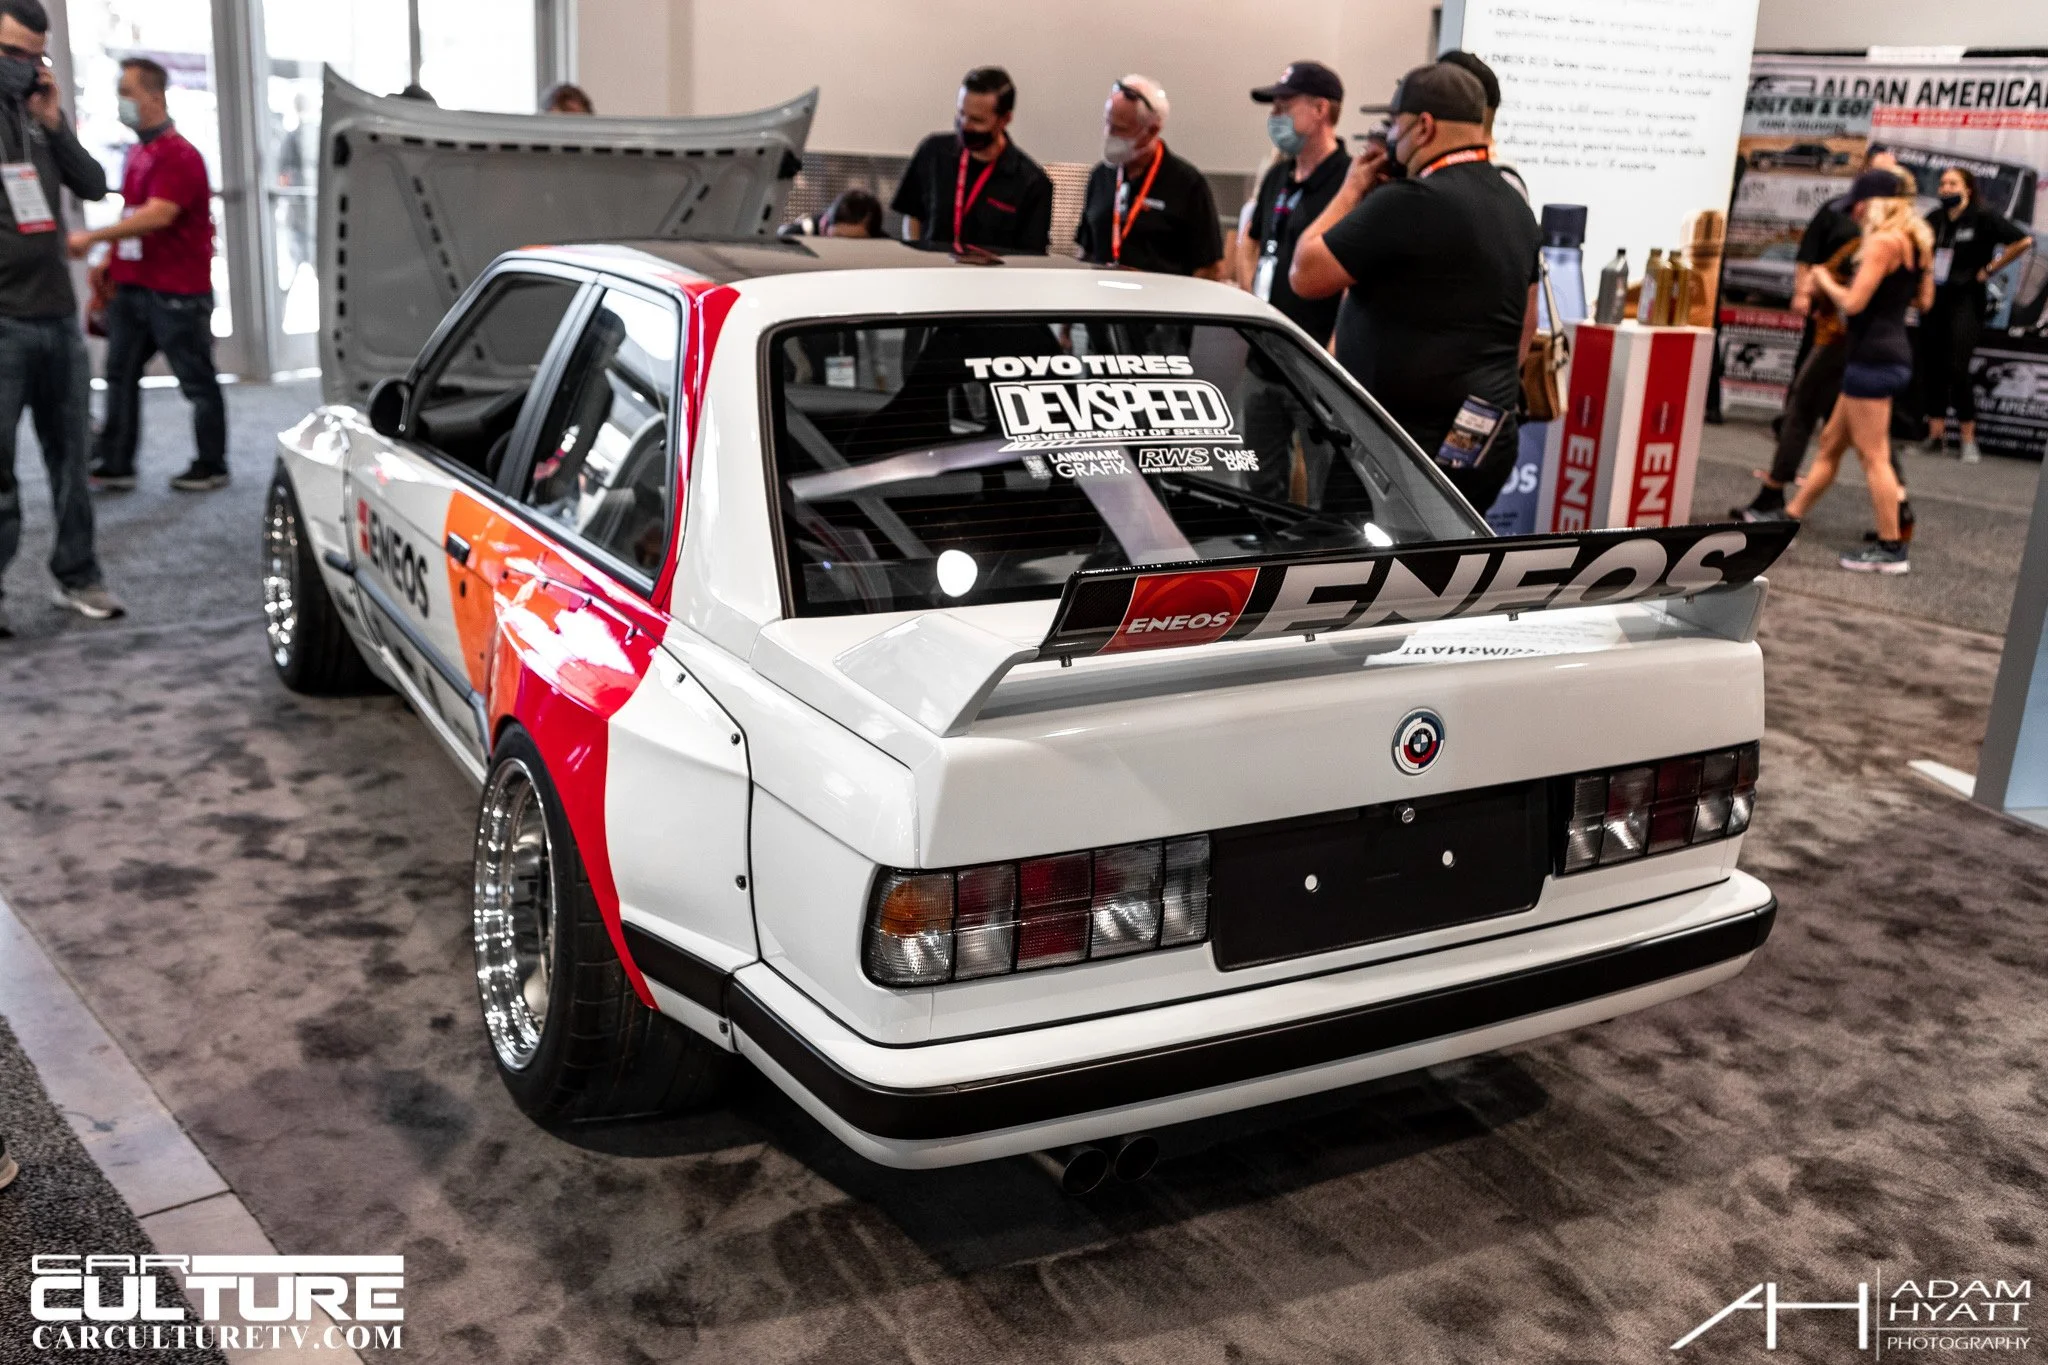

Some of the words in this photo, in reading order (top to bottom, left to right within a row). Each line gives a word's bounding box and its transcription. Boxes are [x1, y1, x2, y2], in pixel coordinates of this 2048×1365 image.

[964, 355, 1082, 379] TOYO
[1081, 354, 1195, 376] TIRES
[996, 382, 1229, 433] DEVSPEED
[1017, 428, 1146, 442] DEVELOPMENT
[1149, 427, 1170, 436] OF
[1173, 427, 1226, 436] SPEED
[1048, 449, 1124, 464] LANDMARK
[1138, 447, 1210, 468] RWS
[1056, 459, 1132, 479] GRAFIX
[370, 508, 429, 619] ENEOS
[1244, 530, 1748, 642] ENEOS
[1125, 611, 1231, 634] ENEOS
